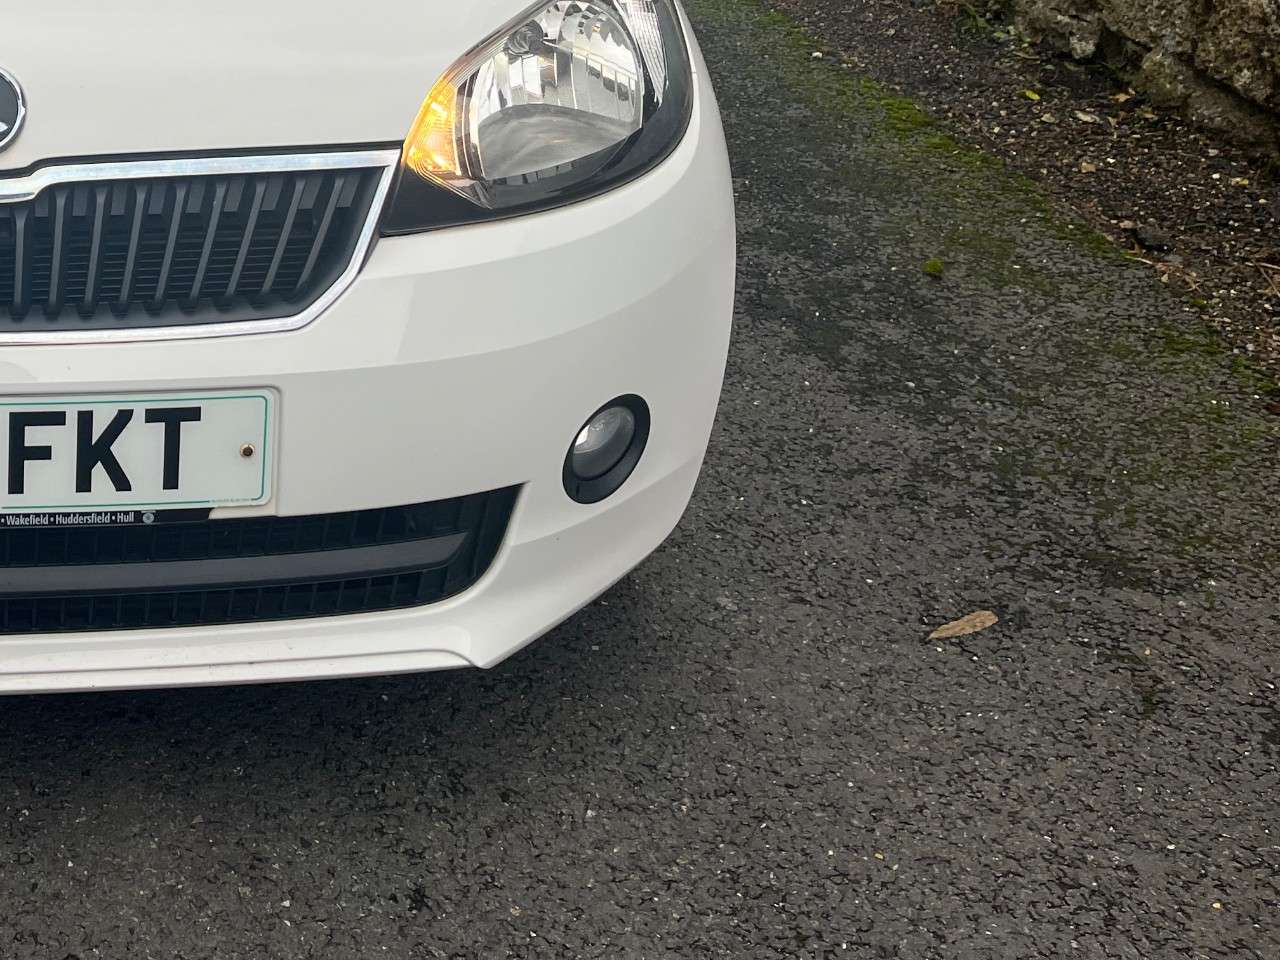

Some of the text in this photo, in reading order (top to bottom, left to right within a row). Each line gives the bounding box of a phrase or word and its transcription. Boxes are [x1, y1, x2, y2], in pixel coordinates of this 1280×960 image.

[7, 406, 203, 495] FKT
[6, 513, 49, 526] Wakefield
[55, 512, 110, 525] Huddersfield
[117, 511, 134, 523] Hull
